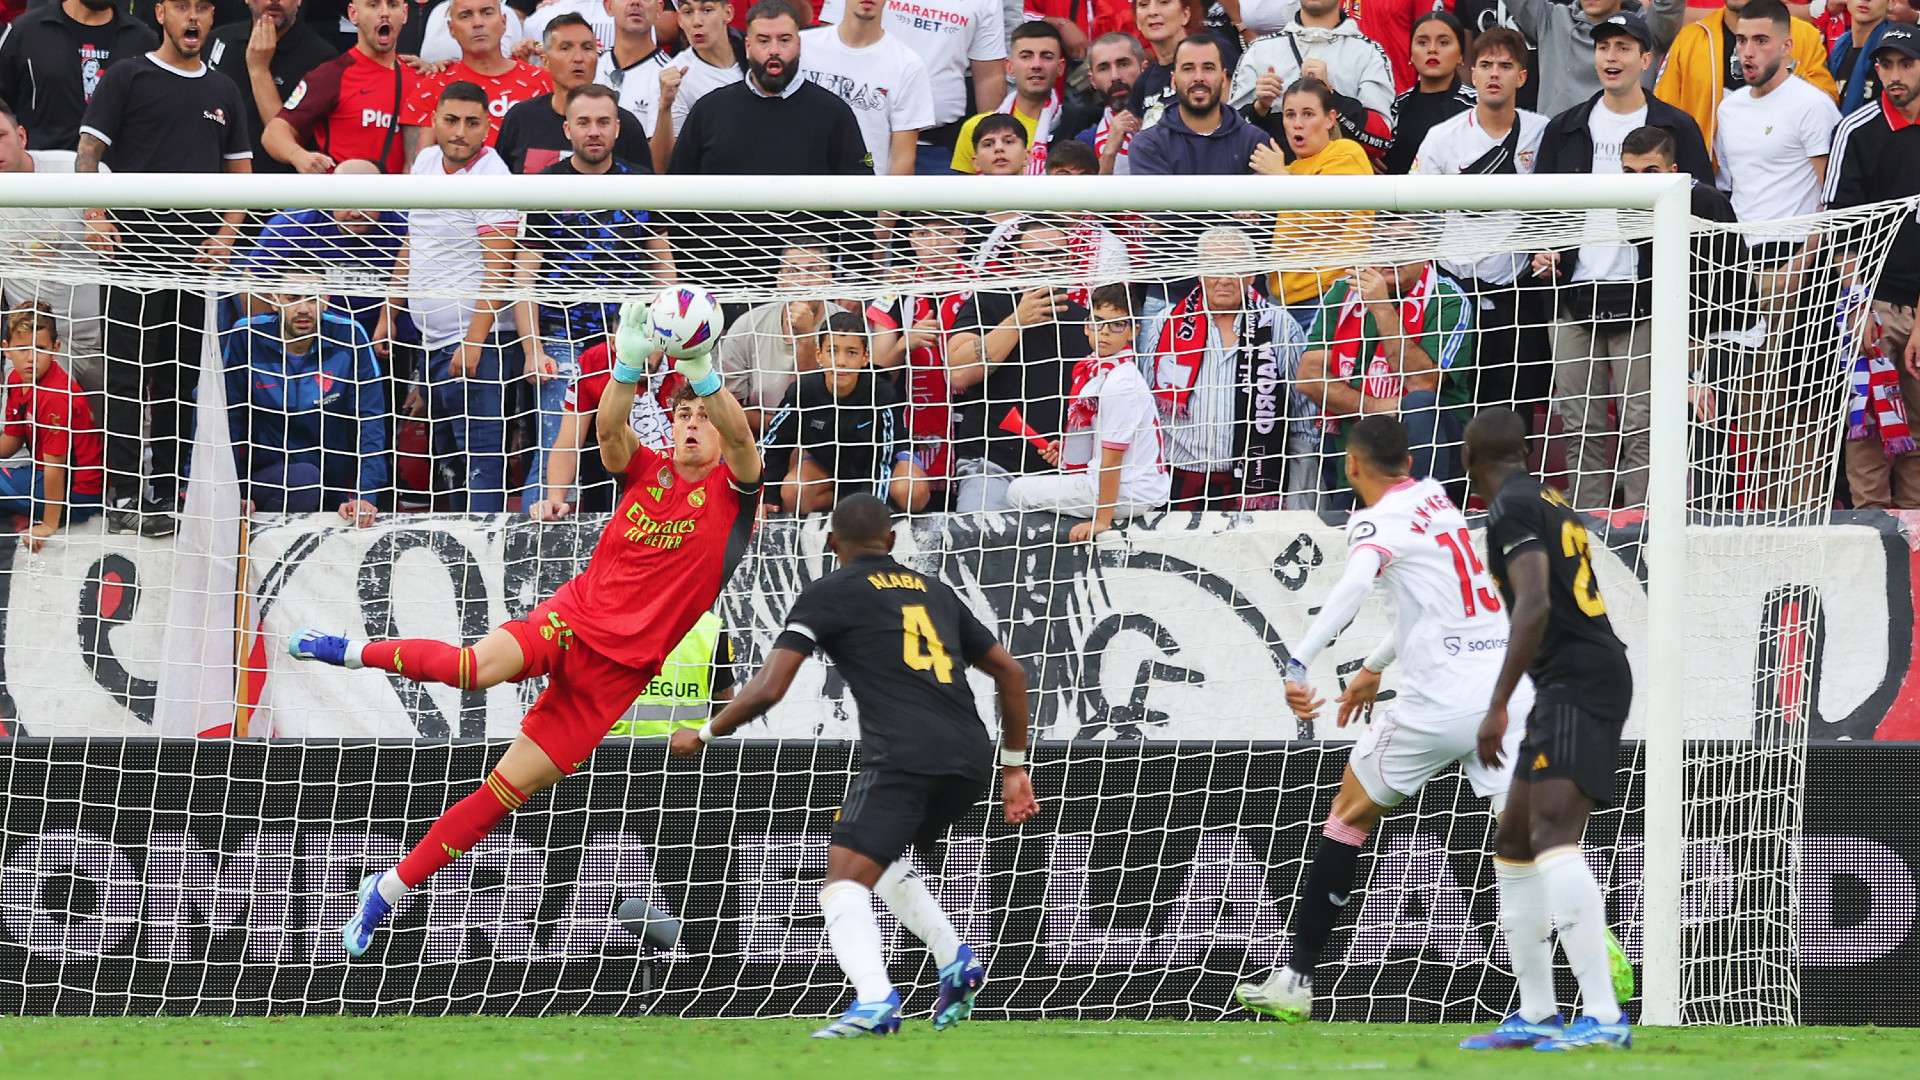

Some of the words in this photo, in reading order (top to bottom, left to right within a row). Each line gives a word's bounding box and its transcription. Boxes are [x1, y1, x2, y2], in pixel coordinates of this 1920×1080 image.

[888, 0, 970, 27] MARATHON
[913, 17, 942, 33] BET
[626, 501, 695, 534] Emirates
[624, 526, 645, 542] FLY
[644, 535, 682, 549] BETTER
[867, 573, 928, 593] ALABA
[1435, 527, 1501, 618] 15
[1562, 520, 1607, 618] 2
[901, 605, 953, 684] 4
[1, 828, 690, 965] OMPRA
[1044, 832, 1291, 966] LA
